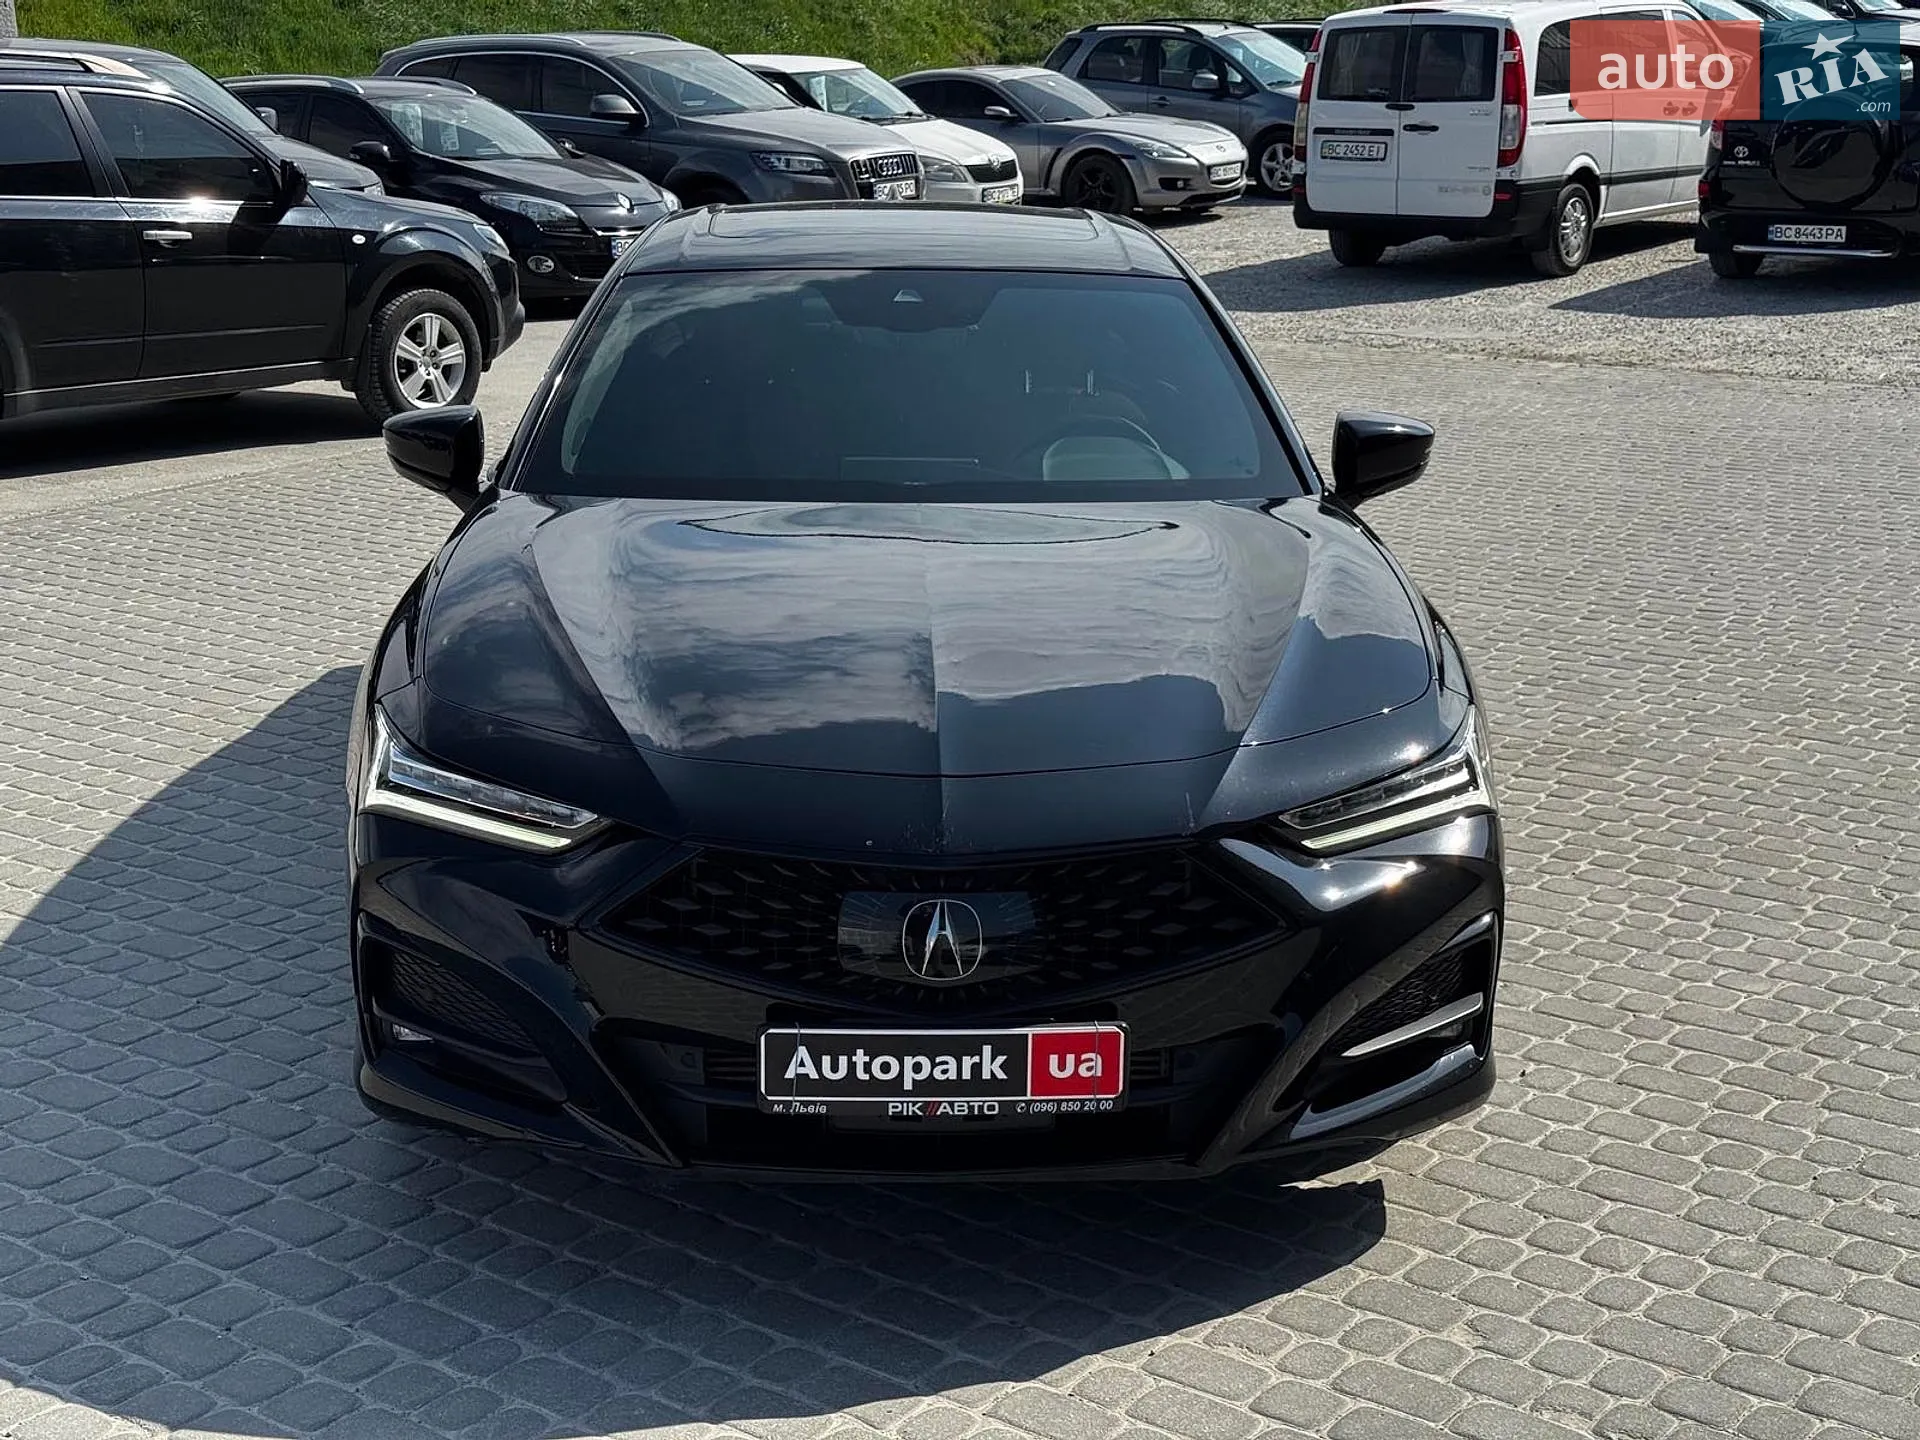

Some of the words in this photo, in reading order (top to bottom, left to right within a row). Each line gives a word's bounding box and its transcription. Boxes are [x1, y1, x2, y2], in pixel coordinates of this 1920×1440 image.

[1328, 144, 1341, 155] BC
[1343, 144, 1366, 156] 2452
[784, 1045, 1008, 1090] Autopark
[1049, 1053, 1102, 1079] ua
[1029, 1102, 1058, 1114] (096)
[1060, 1101, 1081, 1112] 850
[1083, 1101, 1096, 1111] 20
[1100, 1100, 1114, 1111] 00
